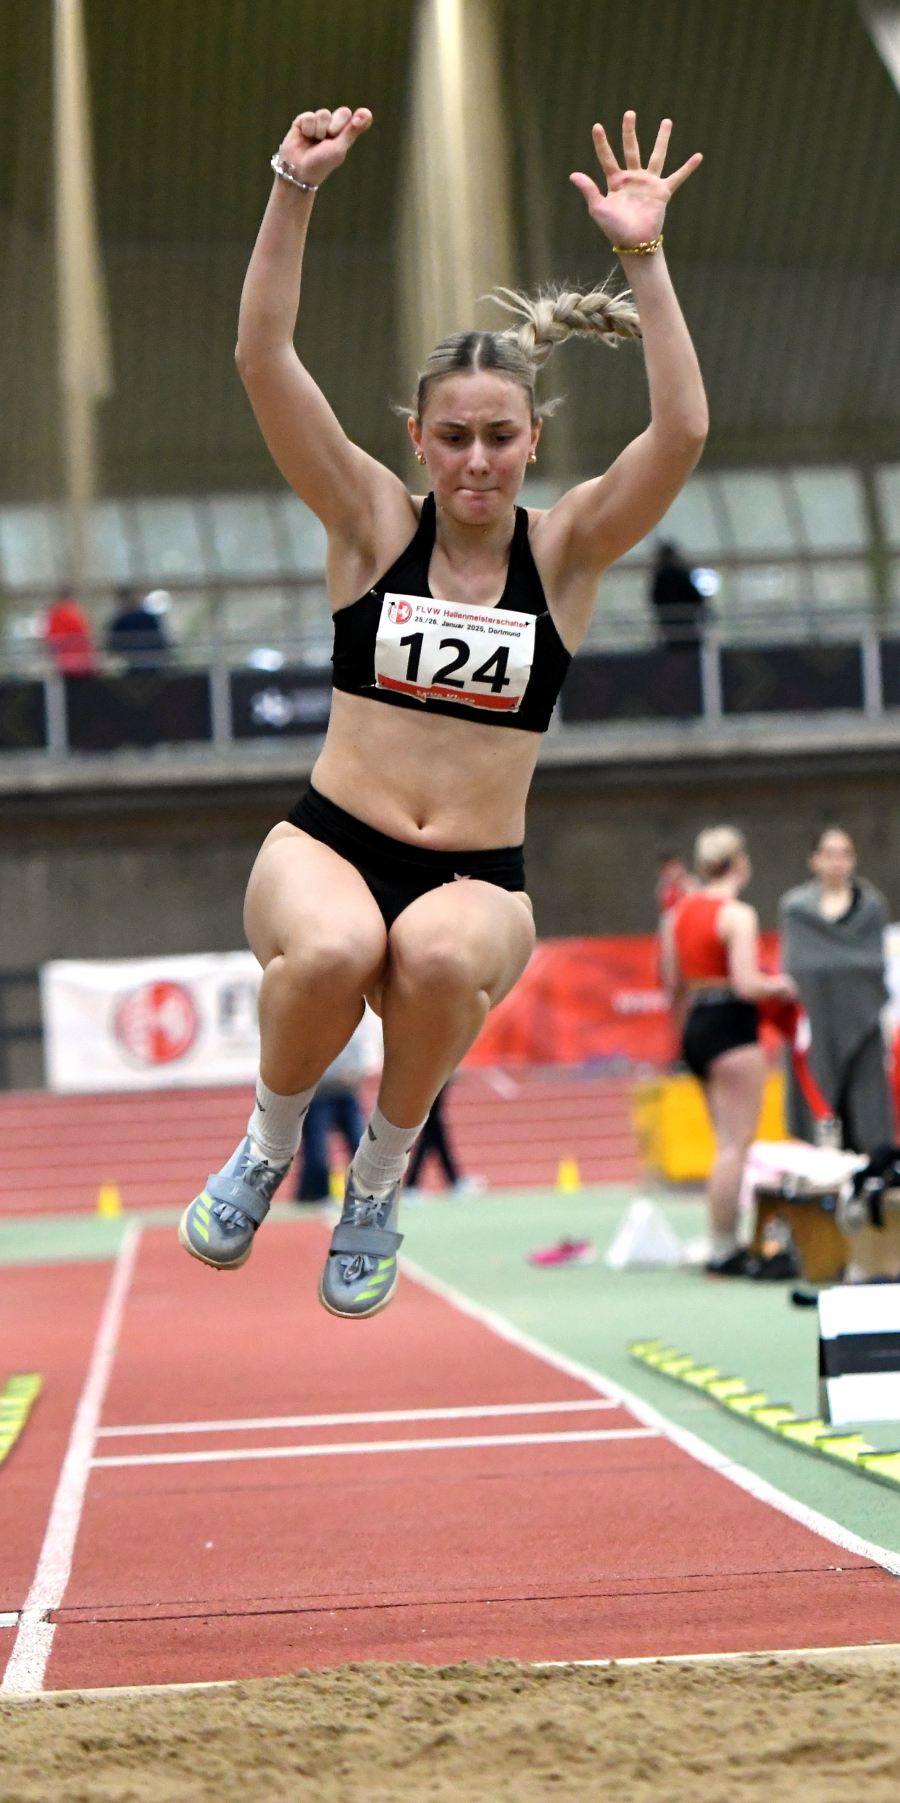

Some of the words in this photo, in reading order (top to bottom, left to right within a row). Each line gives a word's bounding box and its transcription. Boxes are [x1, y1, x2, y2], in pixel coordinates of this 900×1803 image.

[416, 605, 441, 615] FLVW
[414, 615, 439, 626] 25./26.
[441, 620, 464, 630] Januar
[466, 623, 486, 634] 2025,
[488, 627, 521, 638] Dortmund
[399, 632, 510, 693] 124
